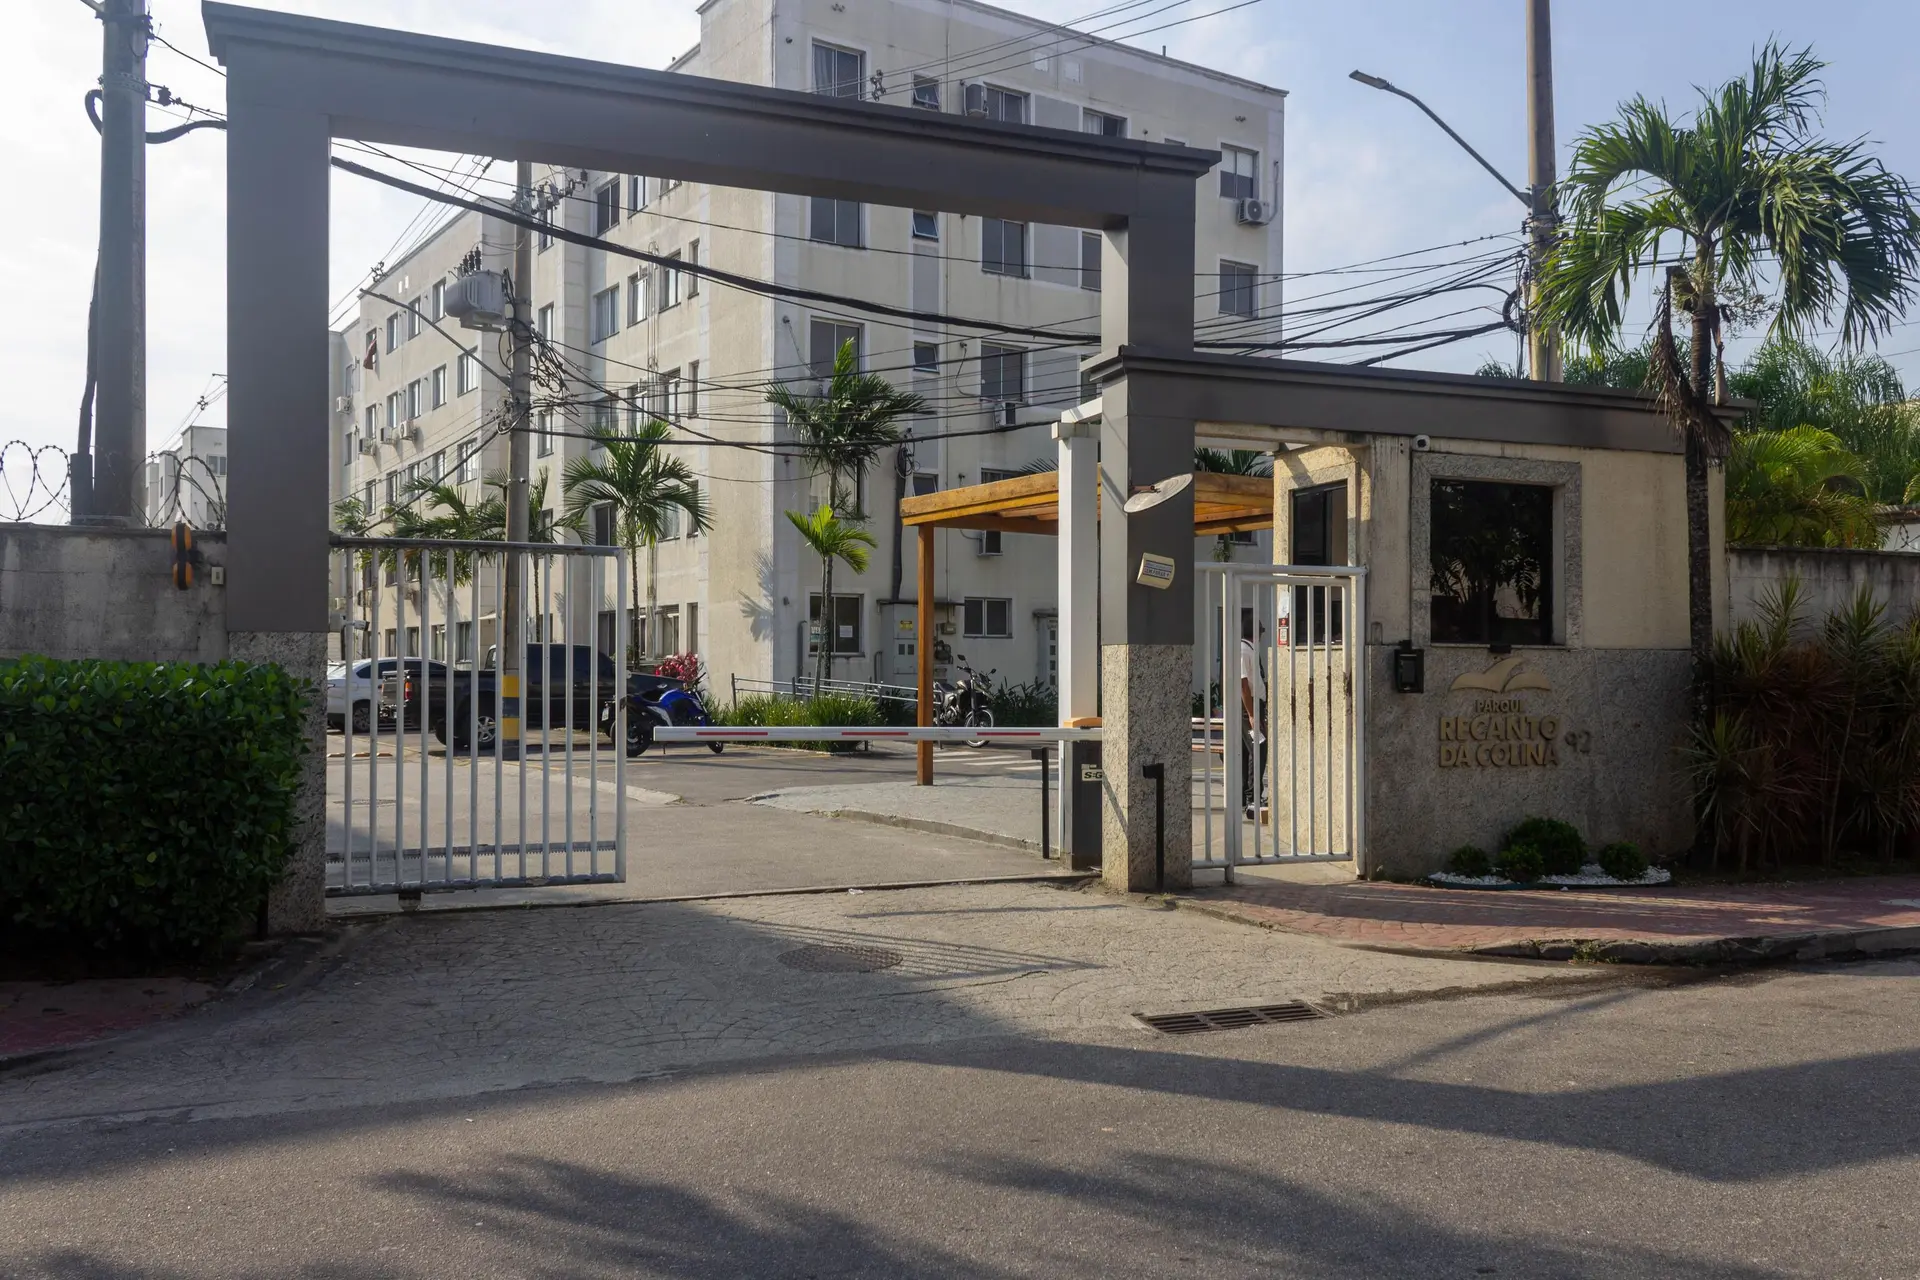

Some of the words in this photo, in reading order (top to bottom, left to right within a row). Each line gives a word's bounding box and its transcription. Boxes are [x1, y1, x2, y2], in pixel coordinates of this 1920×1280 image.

[1439, 714, 1560, 741] RECANTO
[1439, 743, 1471, 767] DA
[1476, 741, 1558, 767] COLINA
